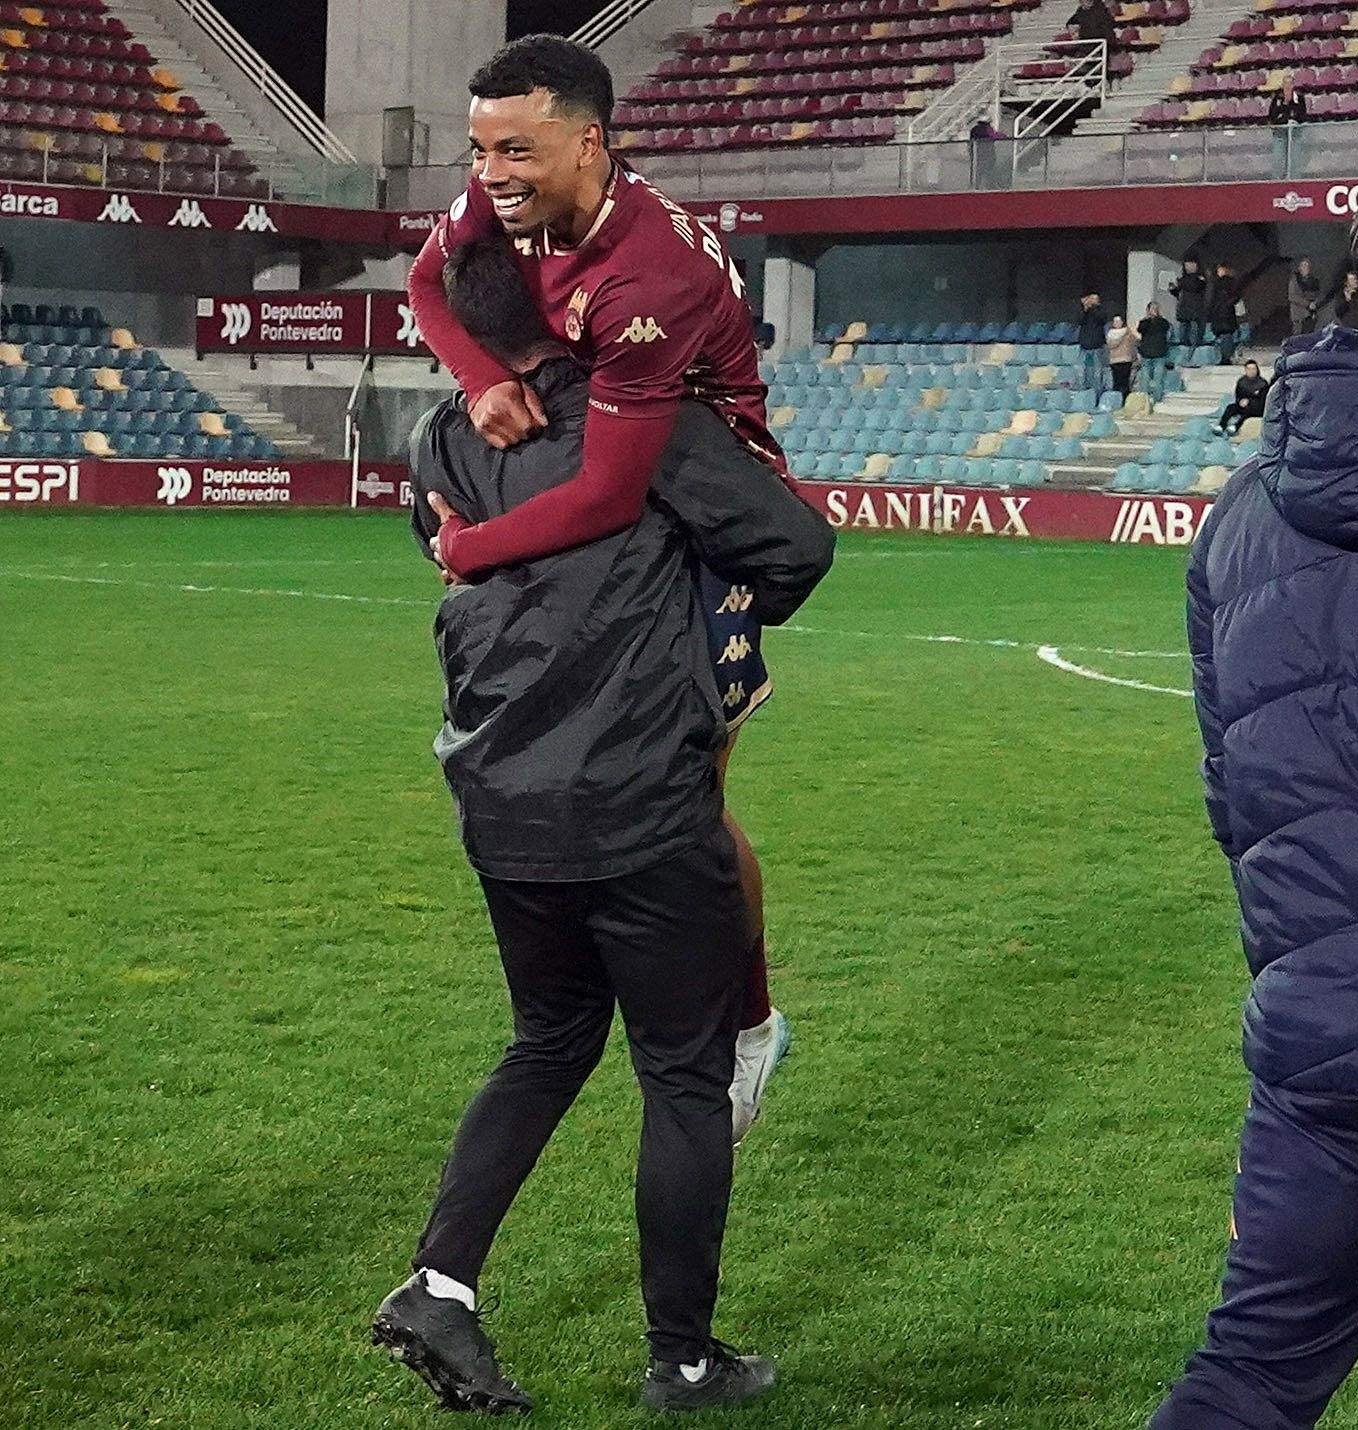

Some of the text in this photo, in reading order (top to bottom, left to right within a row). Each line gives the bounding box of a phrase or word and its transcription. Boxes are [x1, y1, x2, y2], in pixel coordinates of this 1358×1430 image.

[261, 301, 342, 324] Deputación
[261, 324, 342, 341] Pontevedra
[203, 467, 290, 487] Deputación
[203, 486, 290, 501] Pontevedra
[827, 489, 1031, 537] SANIFAX
